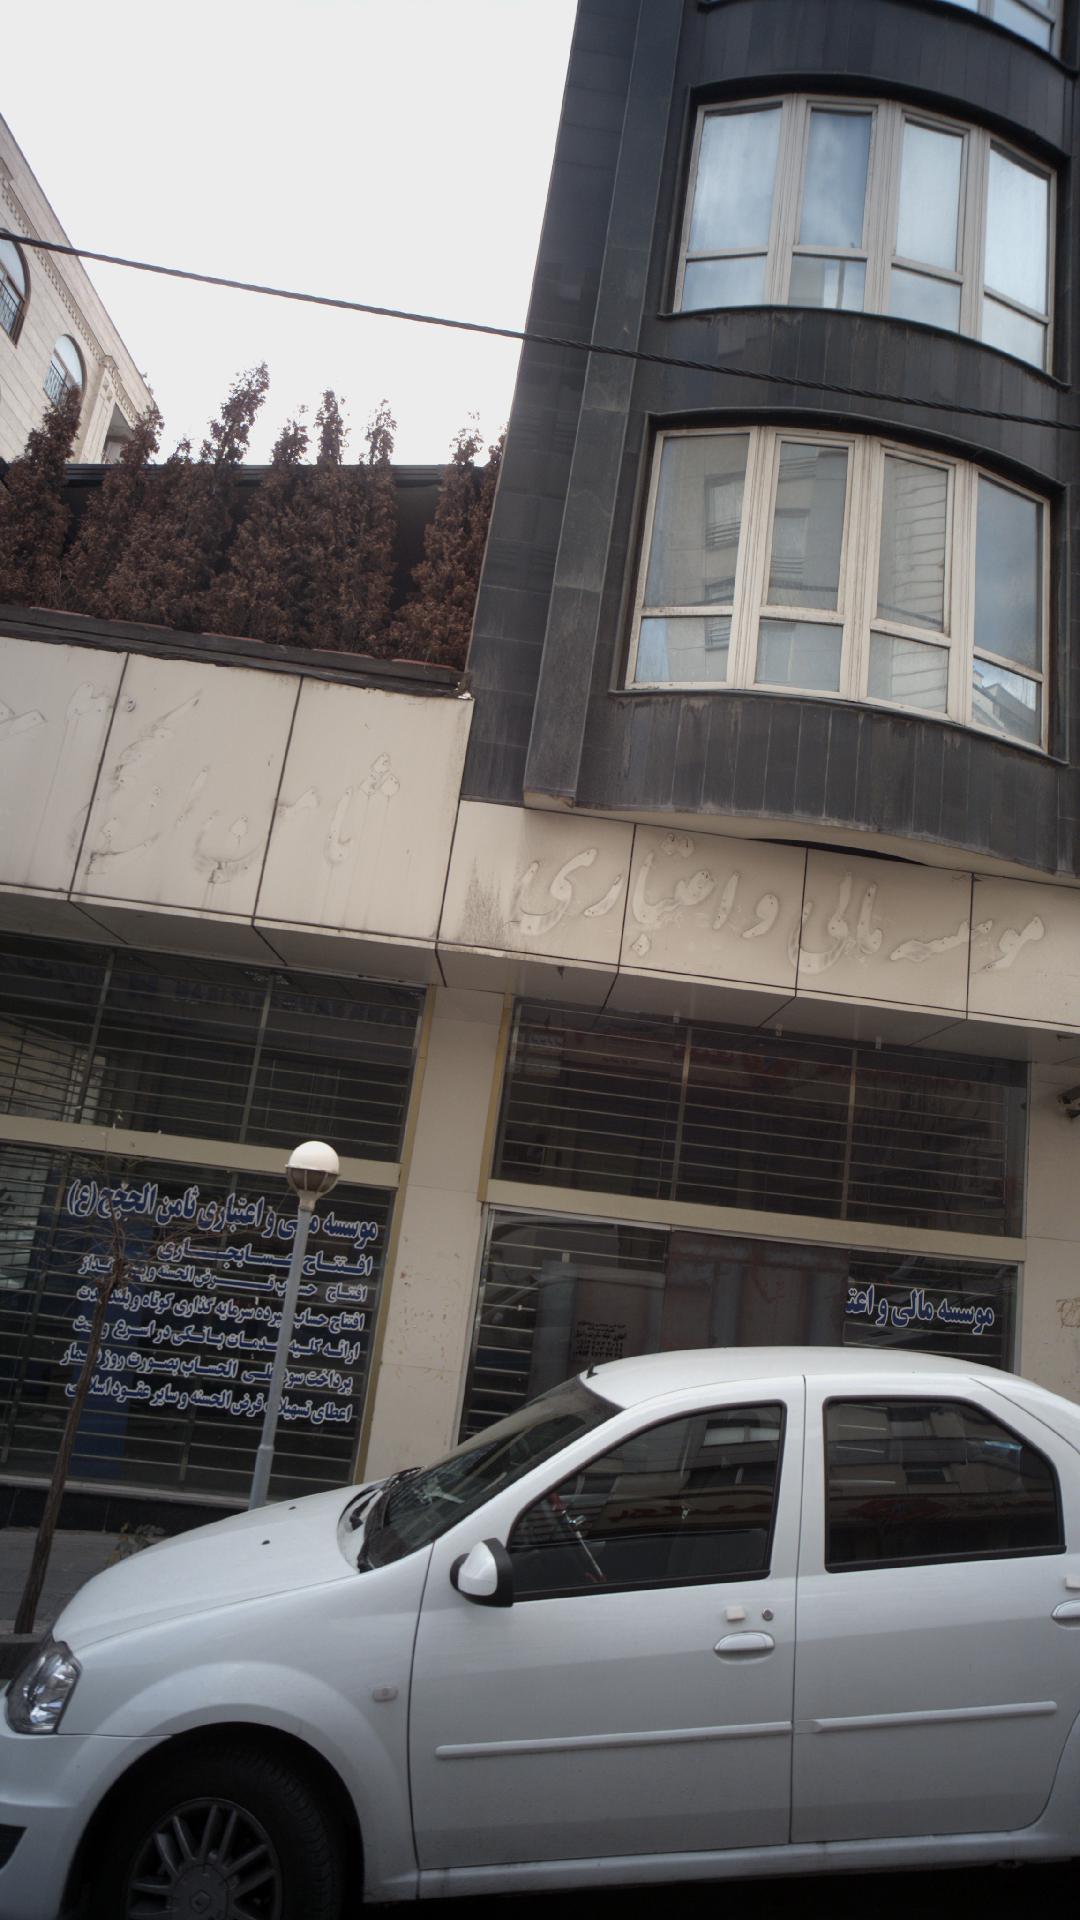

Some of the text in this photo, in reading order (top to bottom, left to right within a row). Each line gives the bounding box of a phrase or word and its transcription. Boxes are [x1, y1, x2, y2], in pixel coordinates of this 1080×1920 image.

[156, 1185, 199, 1225] ثامن
[196, 1192, 265, 1232] اعتباری
[261, 1209, 276, 1239] و
[277, 1214, 320, 1240] می
[323, 1211, 378, 1249] موسسه
[302, 1250, 373, 1276] افتتاح
[130, 1295, 142, 1312] و
[141, 1290, 175, 1314] کوتاه
[326, 1281, 368, 1304] افتتاح
[214, 1298, 256, 1323] سرمایه
[293, 1307, 329, 1329] حساب
[875, 1298, 889, 1327] و
[891, 1288, 934, 1328] مالی
[937, 1299, 995, 1335] موسسه
[112, 1319, 156, 1340] اسرع
[152, 1325, 171, 1343] در
[329, 1311, 365, 1334] افتتاح
[171, 1325, 225, 1350] بانکی
[127, 1352, 180, 1376] بصورت
[180, 1356, 239, 1378] الحساب
[111, 1381, 151, 1403] عقود
[305, 1369, 353, 1395] پرداخت
[149, 1383, 180, 1406] سایر
[177, 1392, 189, 1409] و
[189, 1389, 233, 1409] الحسنه
[230, 1393, 264, 1417] قرض
[310, 1401, 353, 1424] اعطای
